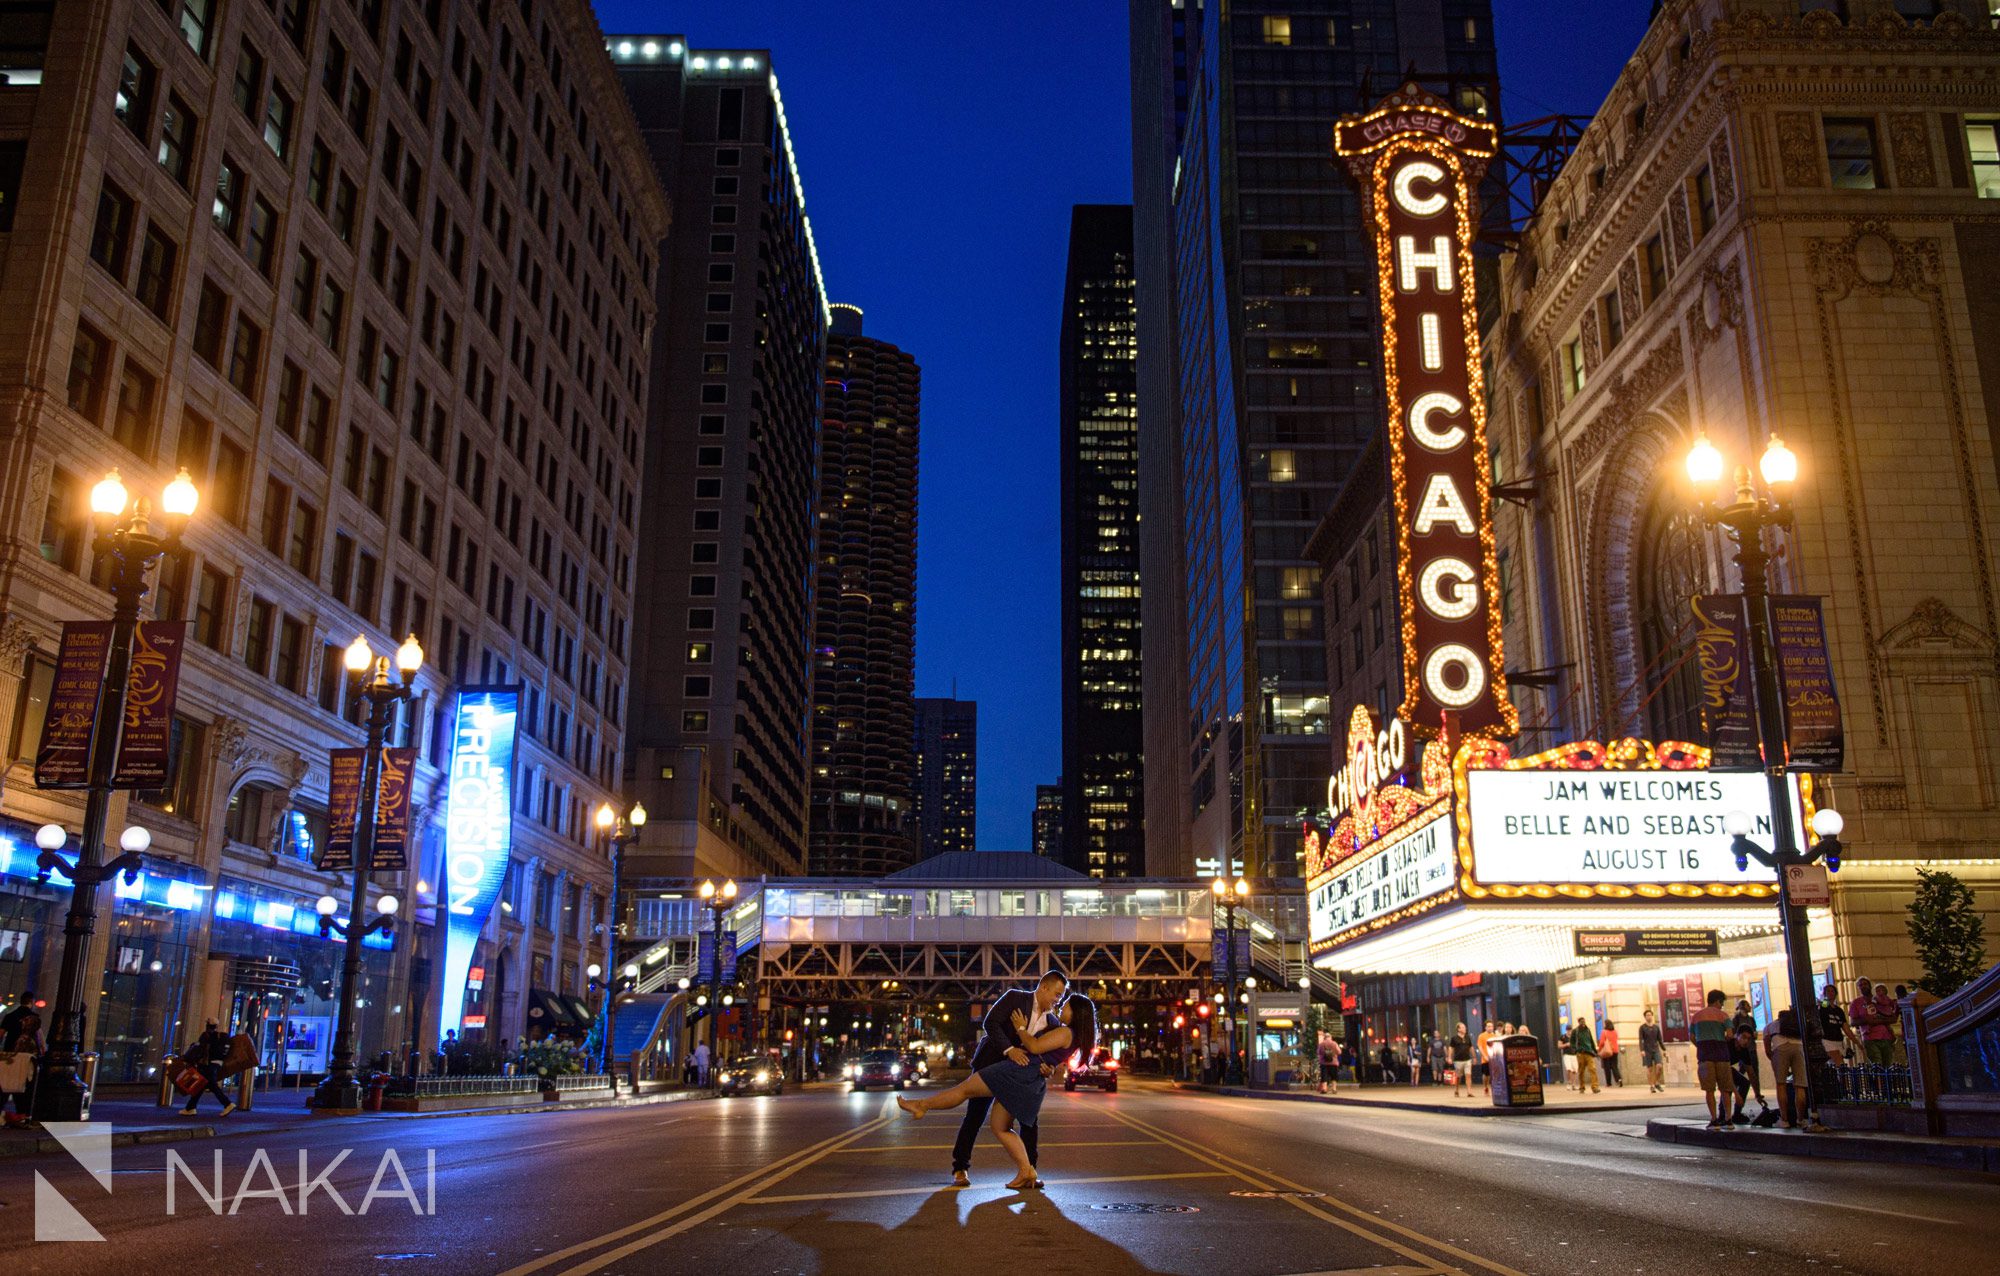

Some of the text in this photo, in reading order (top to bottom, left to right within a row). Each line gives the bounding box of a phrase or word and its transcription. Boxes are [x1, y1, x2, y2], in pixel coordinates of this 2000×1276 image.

[1363, 115, 1441, 142] CHASE
[1393, 162, 1487, 708] CHICAGO
[1712, 610, 1736, 620] Disney
[152, 635, 175, 646] Disney
[1784, 657, 1826, 665] COMIC GOLD
[79, 681, 97, 690] GOLD
[1544, 781, 1723, 801] JAM WELCOMES
[450, 705, 494, 915] PRECISION
[1504, 815, 1772, 835] BELLE AND SEBASTN
[1394, 825, 1436, 873] SEBASTIAN
[1582, 849, 1699, 869] AUGUST 16
